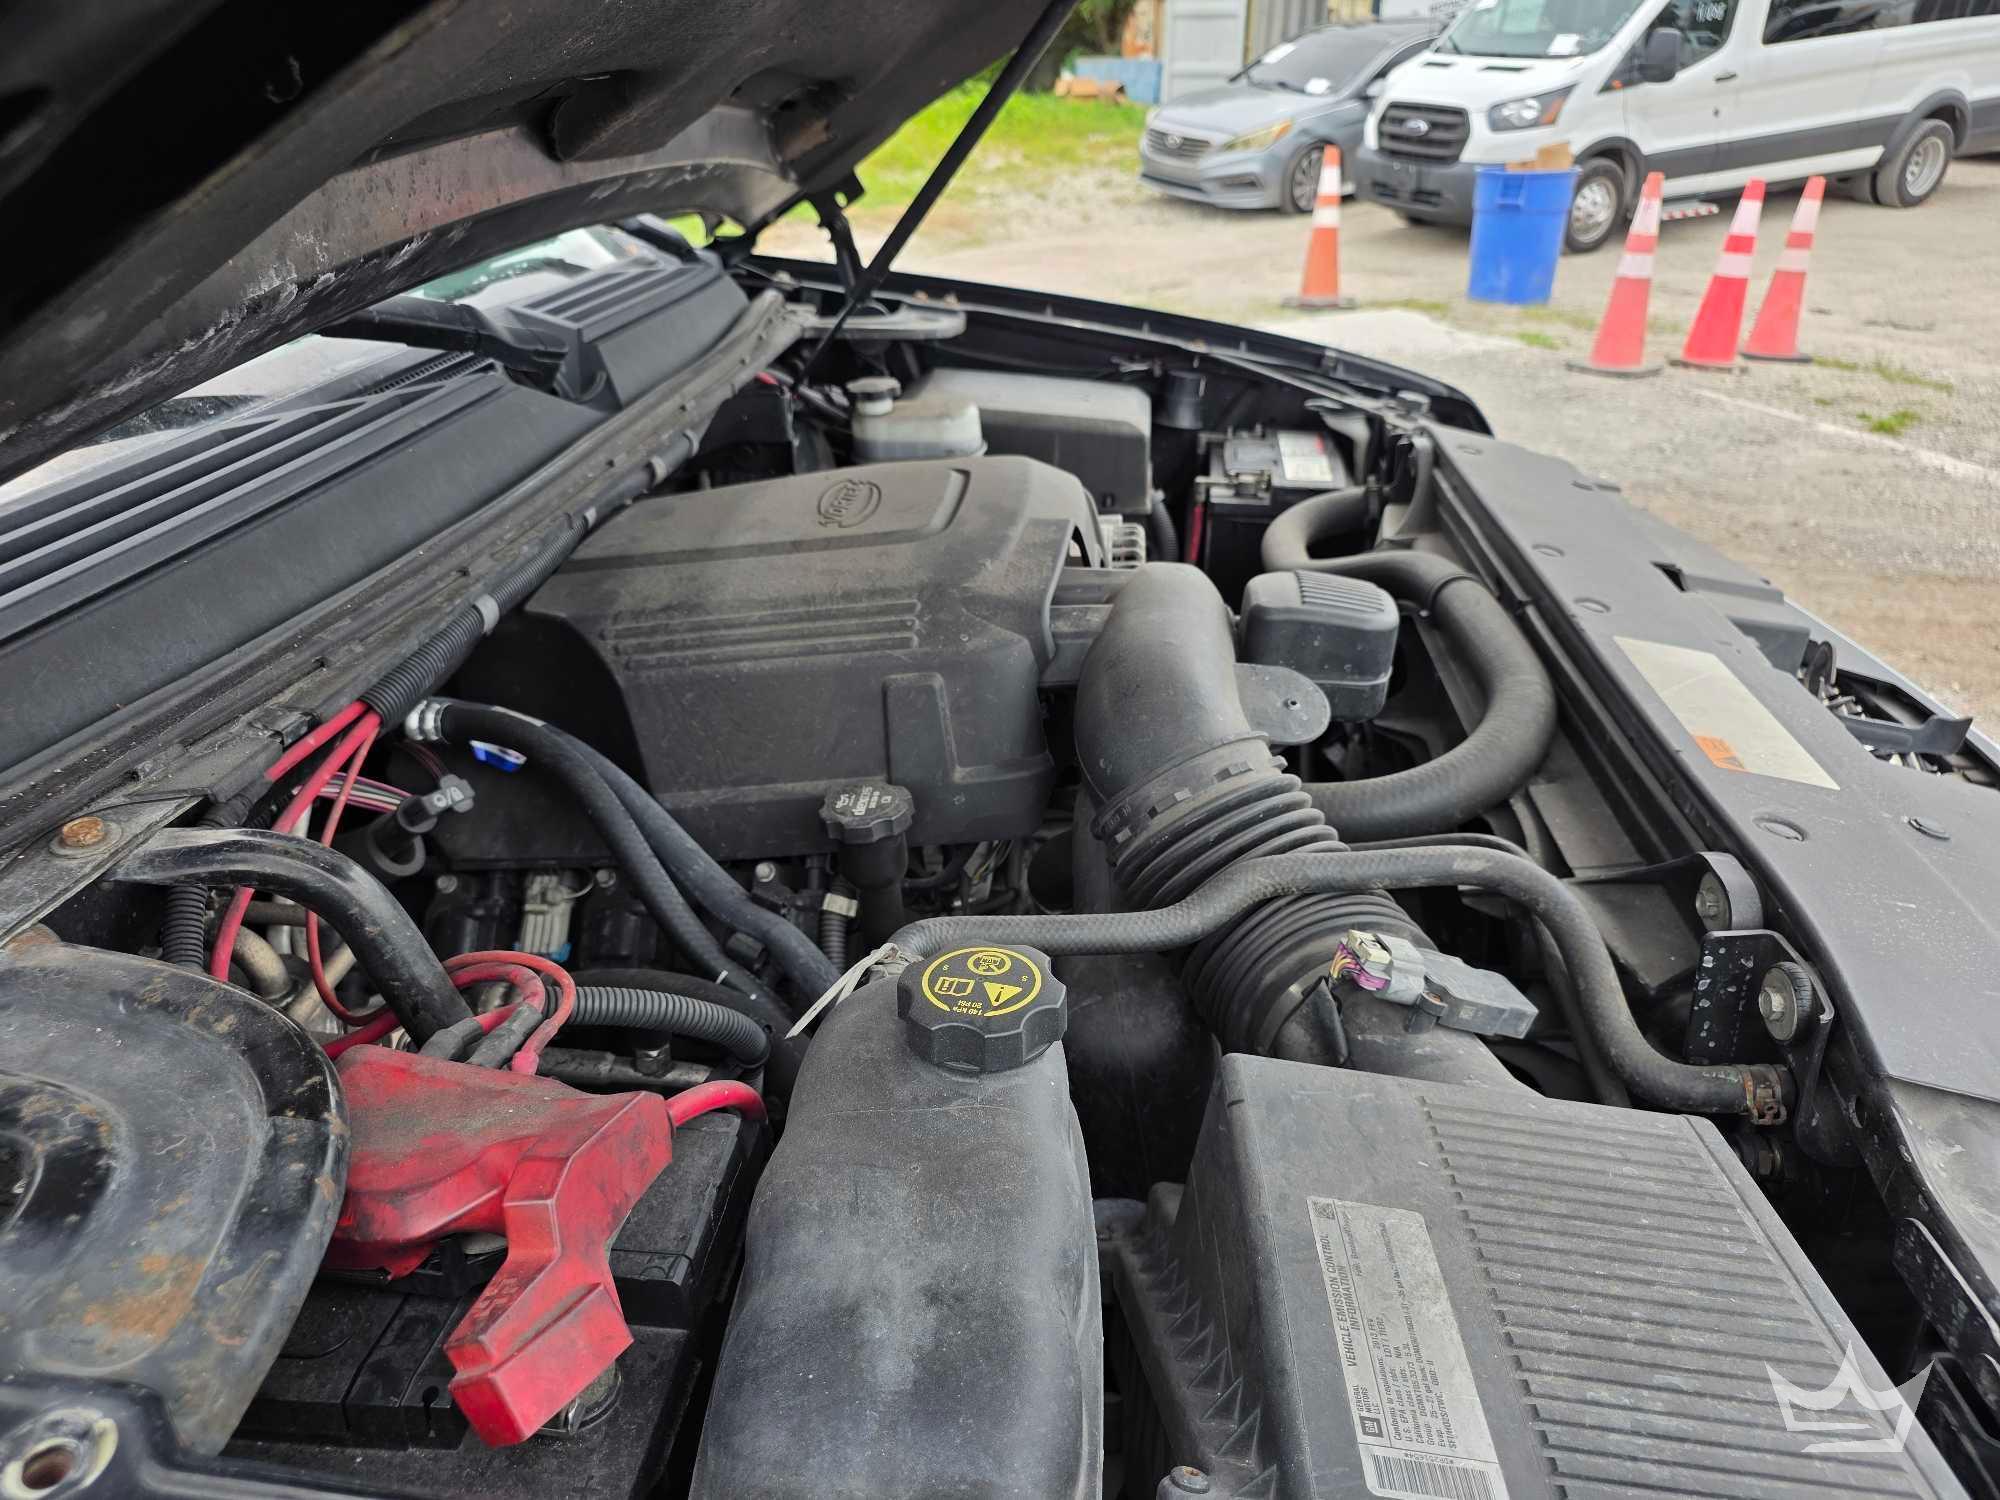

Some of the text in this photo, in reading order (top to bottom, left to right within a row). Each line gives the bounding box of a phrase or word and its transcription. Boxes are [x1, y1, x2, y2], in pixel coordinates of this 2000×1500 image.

[1319, 1233, 1357, 1367] VEHICLE EMISSION CONTROL
[1337, 1265, 1360, 1330] INFORMATION
[1351, 1383, 1364, 1411] GENERAL
[1360, 1386, 1372, 1413] MOTORS
[1371, 1402, 1380, 1414] LLC
[1386, 1406, 1402, 1440] Conforms
[1397, 1409, 1408, 1423] EPA
[1408, 1409, 1424, 1443] California
